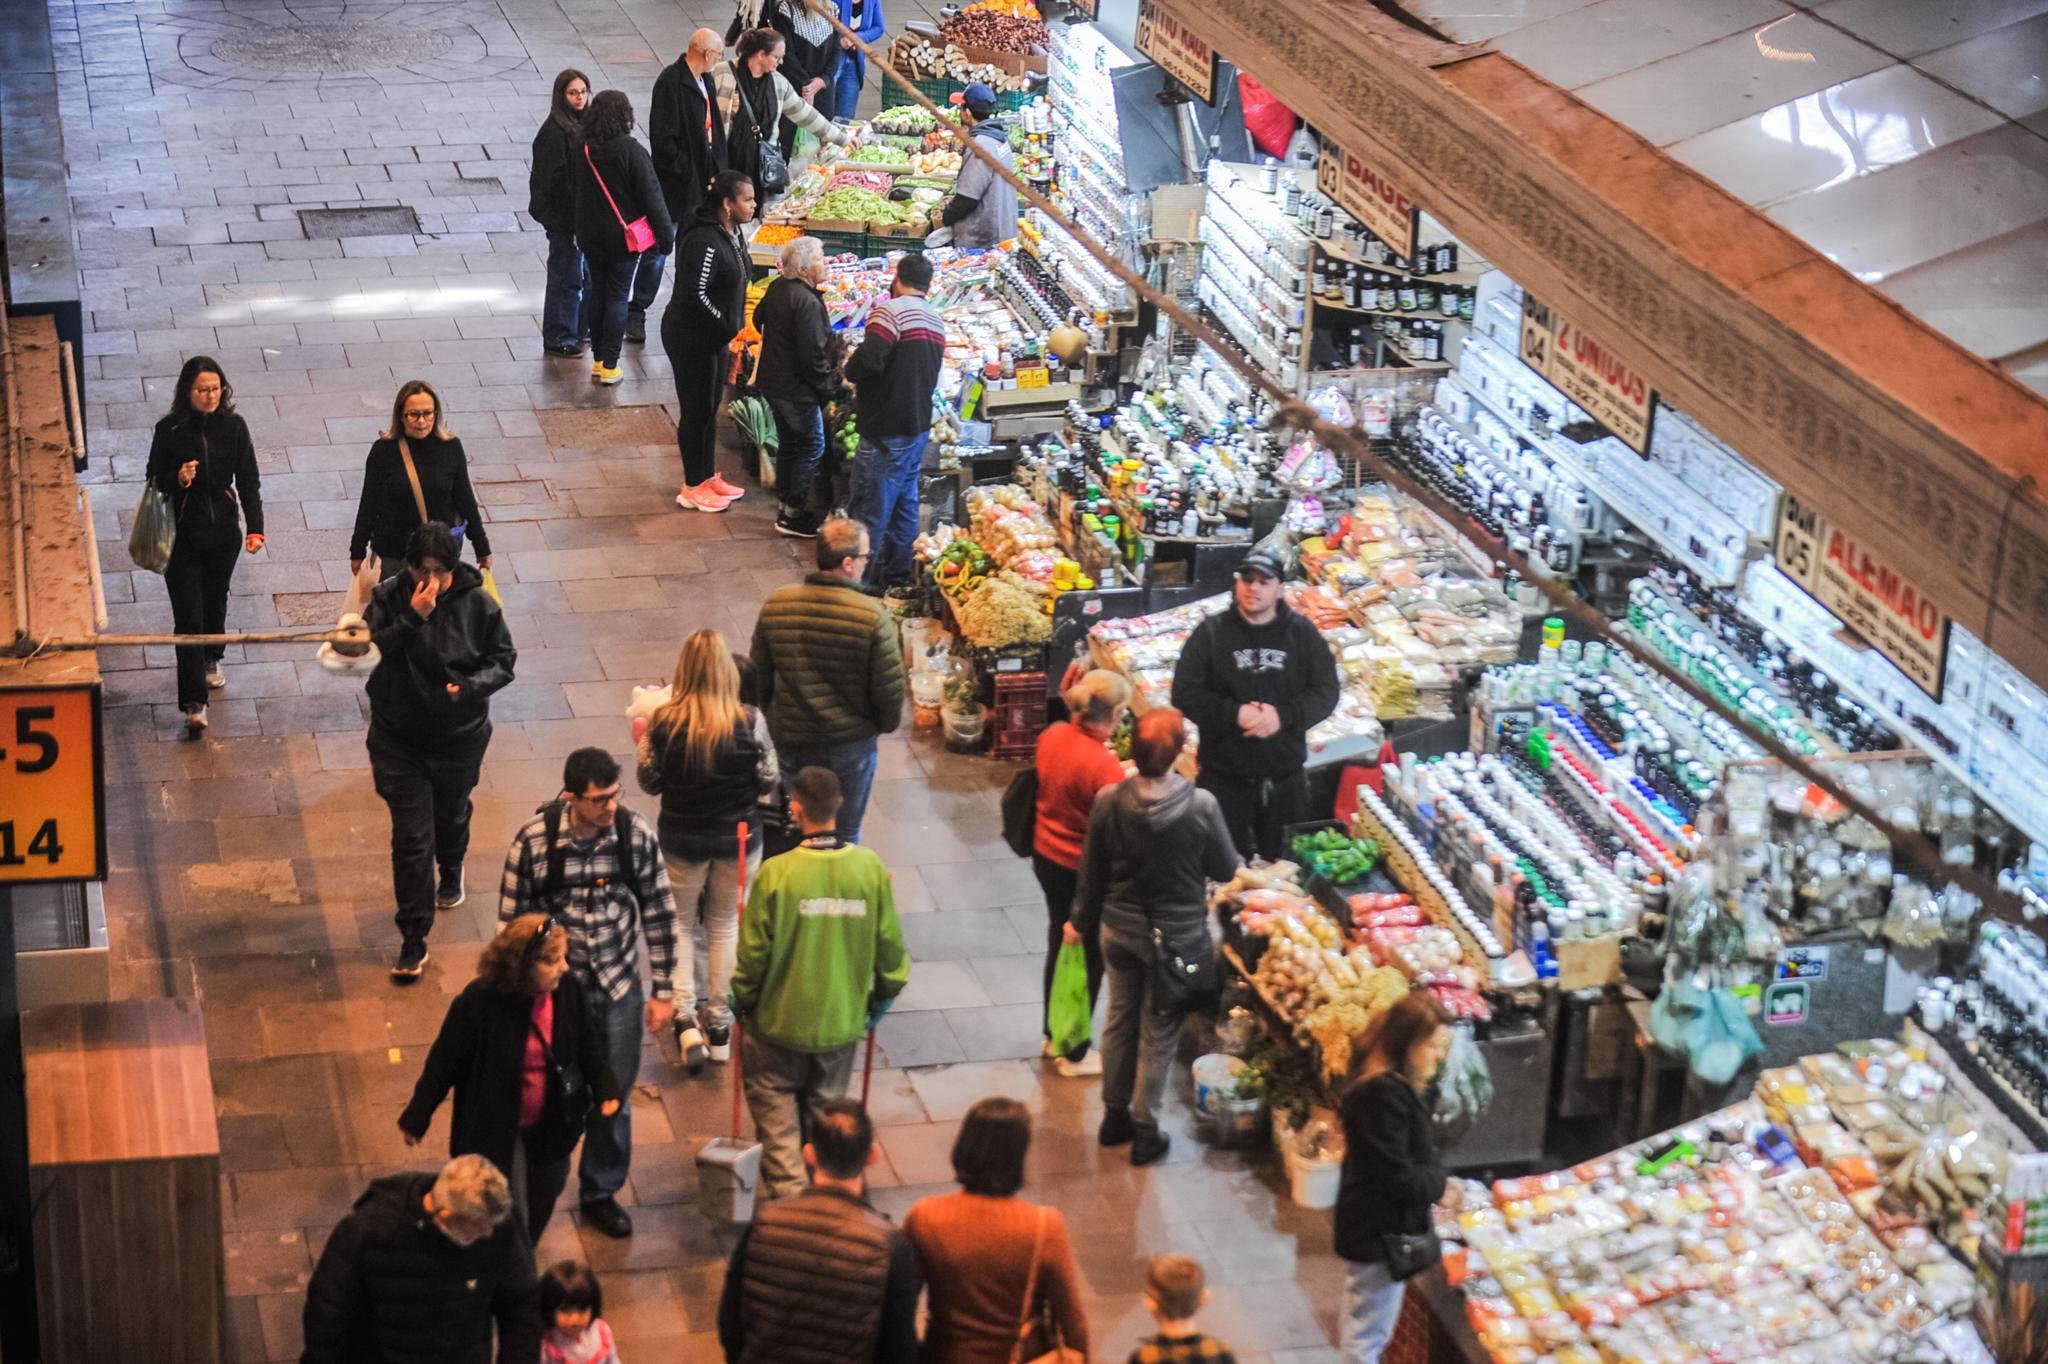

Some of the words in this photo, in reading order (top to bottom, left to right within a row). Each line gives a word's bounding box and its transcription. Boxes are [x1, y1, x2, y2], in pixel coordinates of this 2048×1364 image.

[1139, 22, 1150, 50] 02
[1322, 159, 1337, 193] 03
[1526, 328, 1545, 365] 04
[1783, 530, 1810, 577] 05
[1233, 648, 1288, 669] NKE
